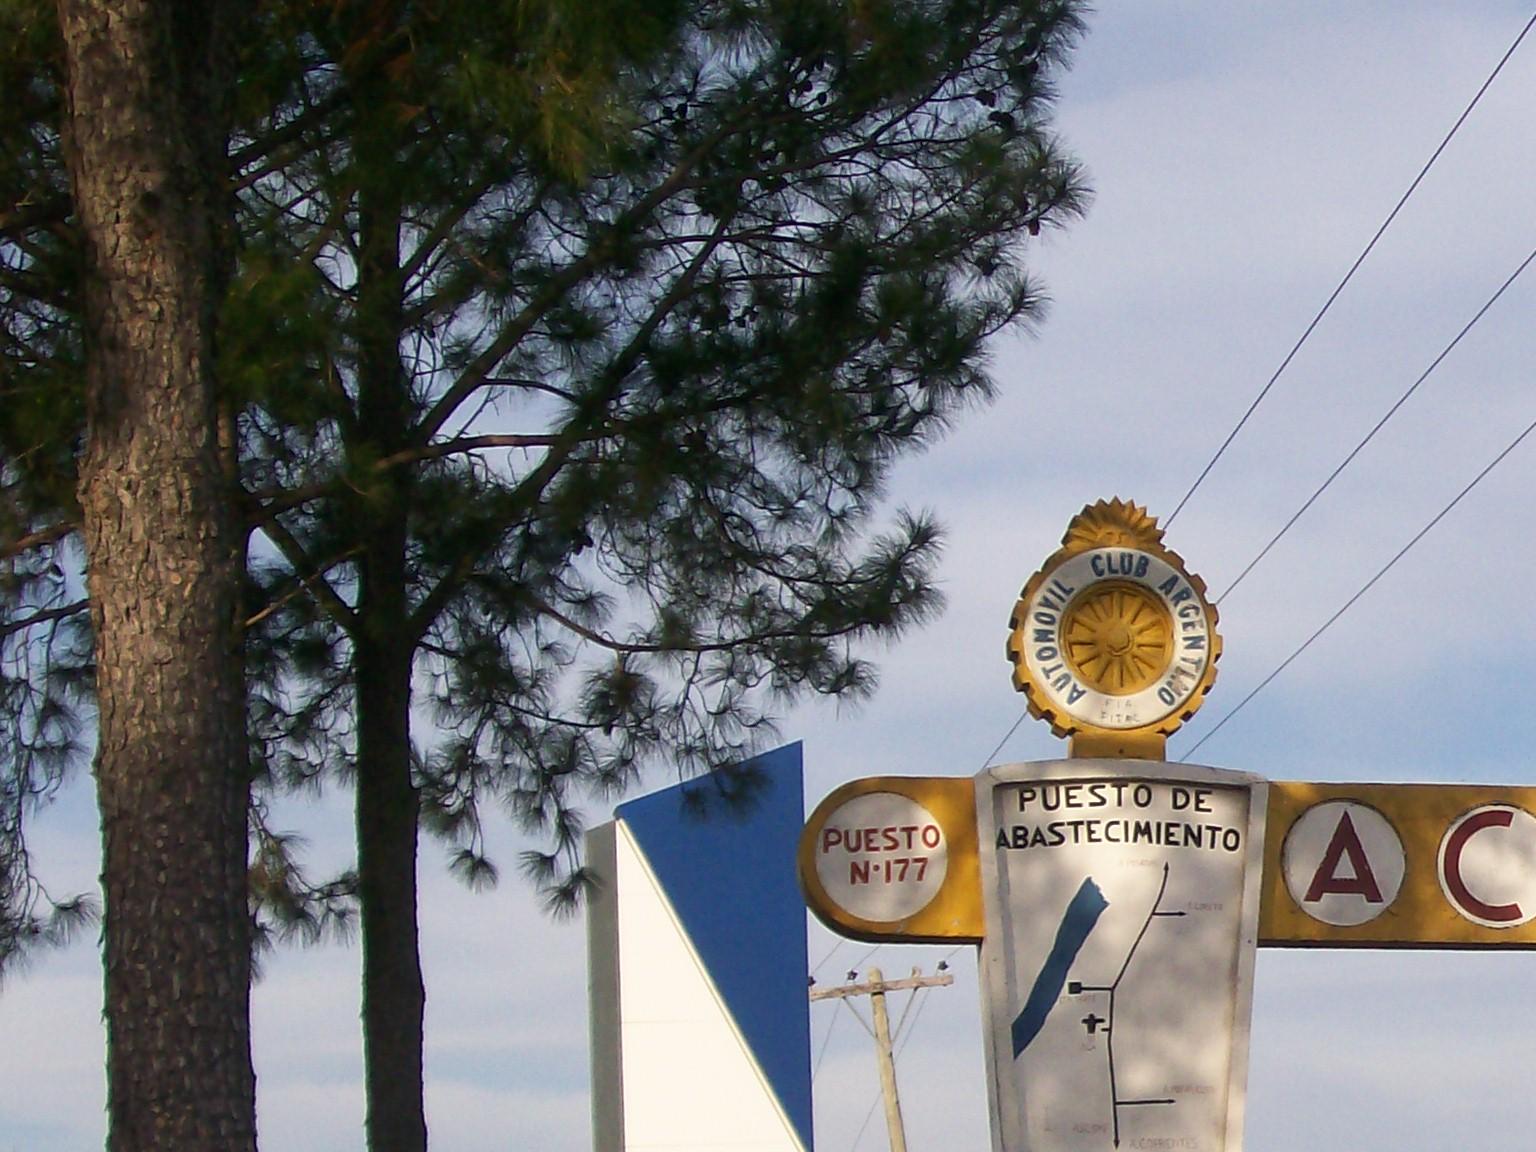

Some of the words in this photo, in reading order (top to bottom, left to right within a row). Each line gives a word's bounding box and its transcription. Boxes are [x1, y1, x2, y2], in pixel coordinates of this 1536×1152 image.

[1033, 579, 1087, 705] AUTOMOVIL
[1091, 552, 1149, 577] CLUB
[1018, 783, 1153, 812] PUESTO
[1171, 787, 1213, 813] DE
[822, 824, 941, 854] PUESTO
[996, 820, 1241, 852] ABASTECIMIENTO
[1303, 809, 1384, 903] A
[1444, 810, 1523, 922] C
